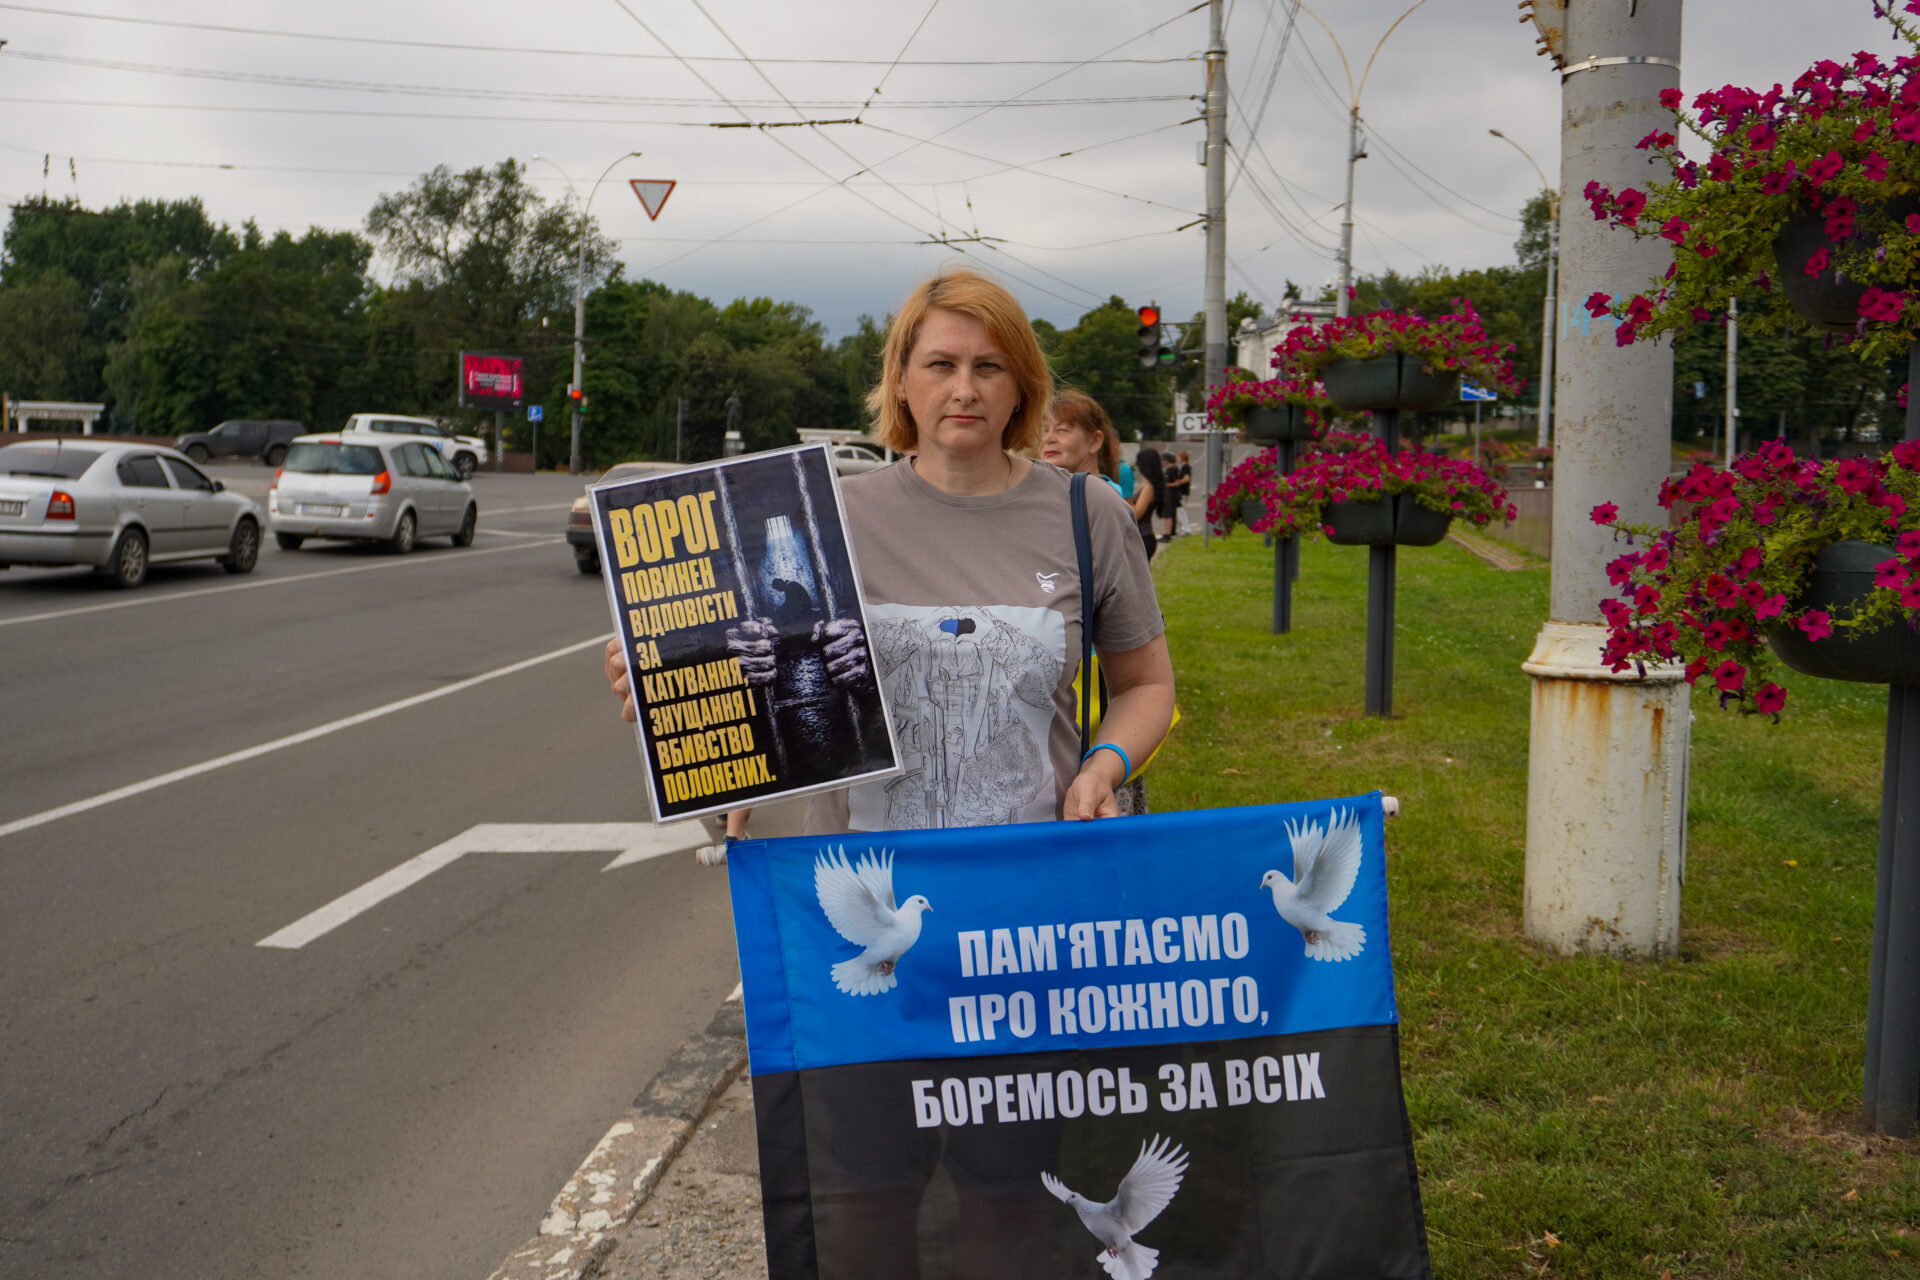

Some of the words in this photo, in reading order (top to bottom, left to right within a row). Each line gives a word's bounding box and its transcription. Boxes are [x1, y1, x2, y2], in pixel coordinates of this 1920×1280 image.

[609, 491, 720, 568] ВОРОГ
[621, 557, 716, 604] ПОВИНЕН
[629, 591, 738, 638] ВІДПОВІСТИ
[636, 641, 662, 670] ЗА
[642, 657, 750, 704] КАТУВАННЯ,
[649, 691, 747, 737] ЗНУЩАННЯ
[746, 689, 757, 717] І
[656, 724, 755, 770] ВБИВСТВО
[663, 754, 777, 804] ПОЛОНЕНИХ.
[958, 913, 1249, 977] ПАМ'ЯТАЄМО
[949, 992, 1036, 1043] ПРО
[1048, 977, 1268, 1035] КОЖНОГО,
[912, 1068, 1148, 1127] БОРЕМОСЬ
[1158, 1063, 1218, 1111] ЗА
[1226, 1052, 1326, 1106] ВСІХ
